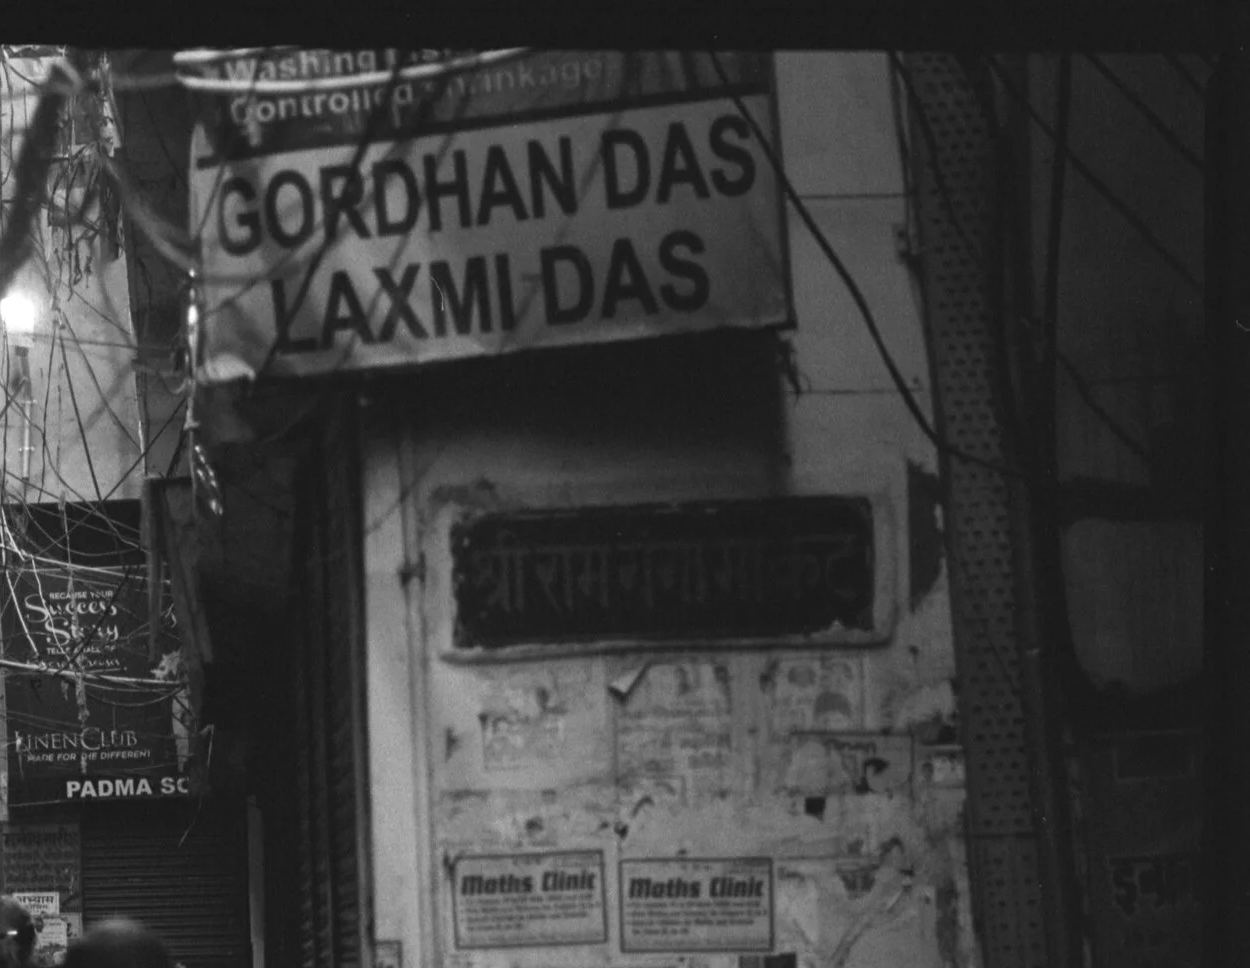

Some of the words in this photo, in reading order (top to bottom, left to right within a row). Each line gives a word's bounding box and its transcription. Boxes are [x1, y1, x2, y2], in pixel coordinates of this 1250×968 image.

[218, 137, 577, 257] GORDHAN
[601, 114, 757, 210] DAS
[271, 251, 516, 355] LAXMI
[541, 229, 713, 326] DAS
[49, 591, 87, 599] BECAUSE
[57, 753, 77, 761] FOR
[100, 750, 151, 760] DIFFERENT
[66, 778, 152, 798] PADMA
[461, 874, 533, 895] Maths
[542, 870, 596, 892] Clinic
[629, 877, 701, 899] Maths
[709, 875, 764, 898] Clinic
